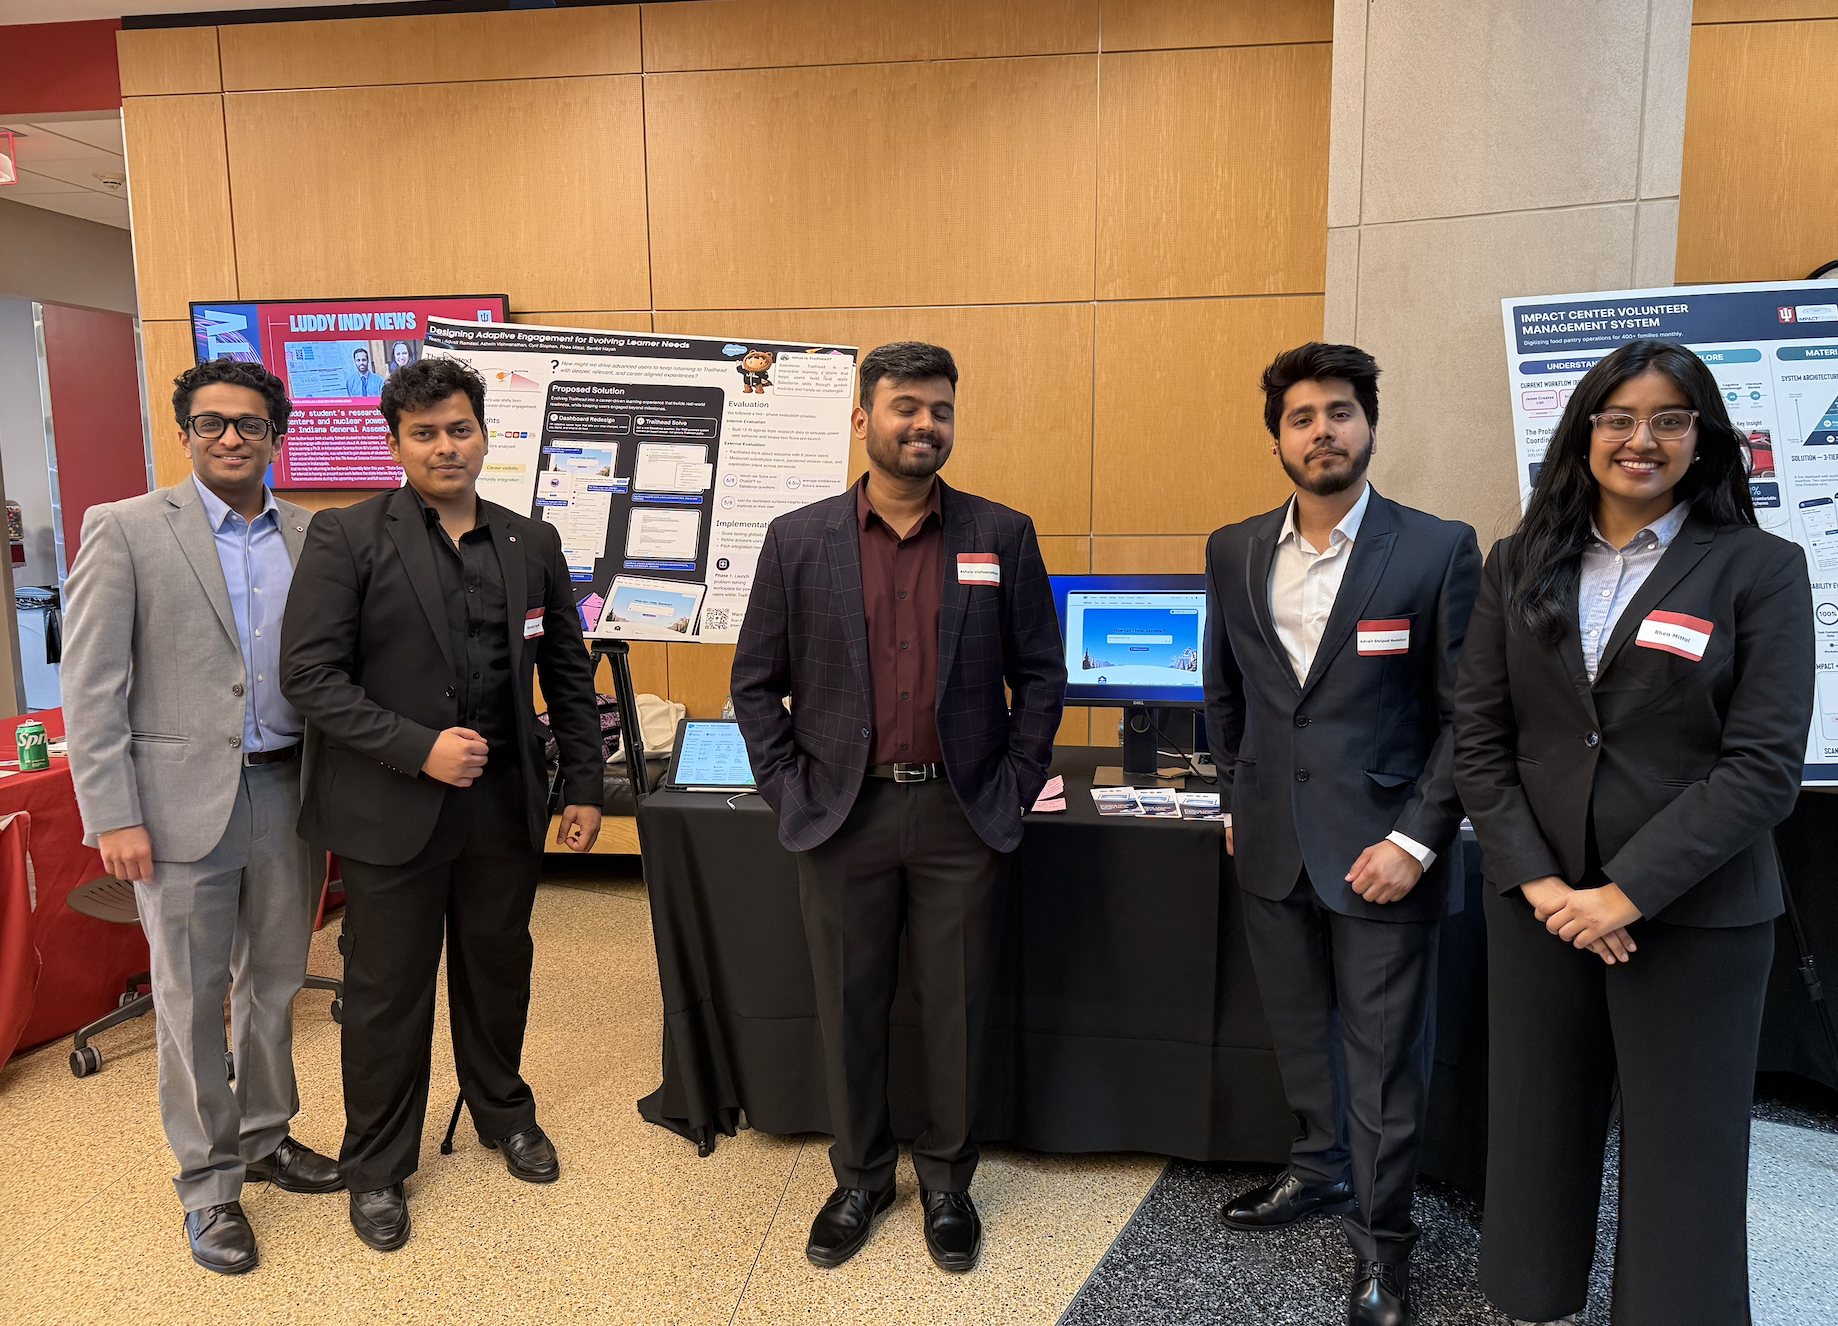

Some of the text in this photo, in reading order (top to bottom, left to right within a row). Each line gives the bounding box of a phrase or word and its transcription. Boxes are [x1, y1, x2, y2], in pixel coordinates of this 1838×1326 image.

[1520, 304, 1689, 323] IMPACT CENTER VOLUNTEER
[290, 312, 416, 332] LUDDY INDY NEWS
[1522, 318, 1660, 335] MANAGEMENT SYSTEM
[429, 325, 474, 340] Designing
[476, 331, 515, 340] Adaptive
[517, 332, 574, 343] Engagement
[588, 337, 625, 346] Evolving
[626, 339, 660, 347] Learner
[661, 340, 690, 348] Needs
[1582, 335, 1612, 343] operations
[1546, 361, 1598, 370] UNDERSTAN
[552, 385, 625, 395] Proposed Solution
[716, 520, 770, 529] Implementati
[1672, 633, 1691, 643] Mittal
[19, 732, 46, 750] Spr
